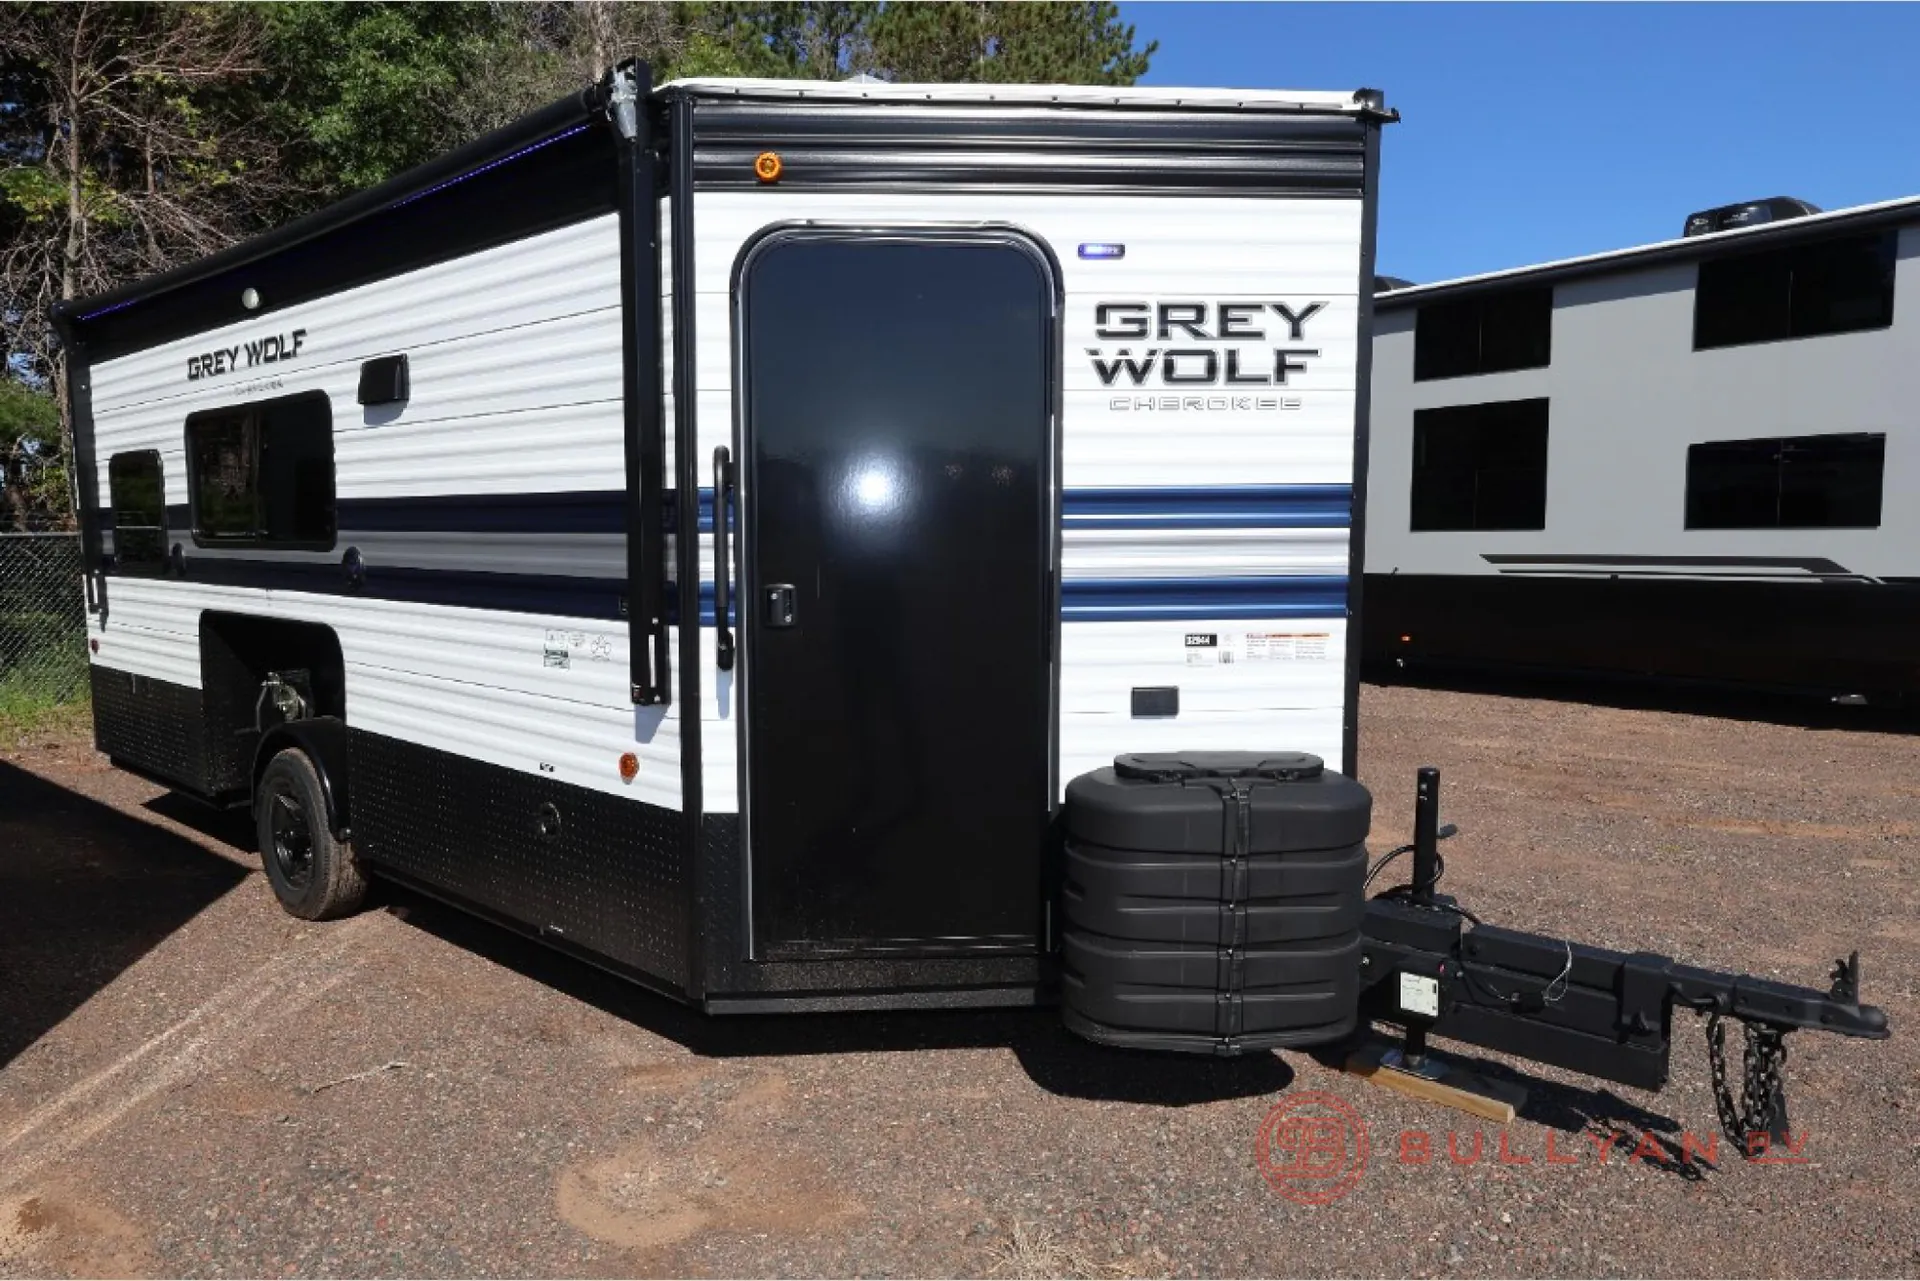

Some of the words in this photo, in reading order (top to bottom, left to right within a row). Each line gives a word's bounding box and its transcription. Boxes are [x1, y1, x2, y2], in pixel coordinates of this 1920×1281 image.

[1094, 300, 1330, 340] GREY
[187, 345, 239, 381] GREY
[243, 328, 307, 368] WOLF
[1083, 347, 1322, 386] WOLF
[1109, 396, 1302, 411] CHEROKEE
